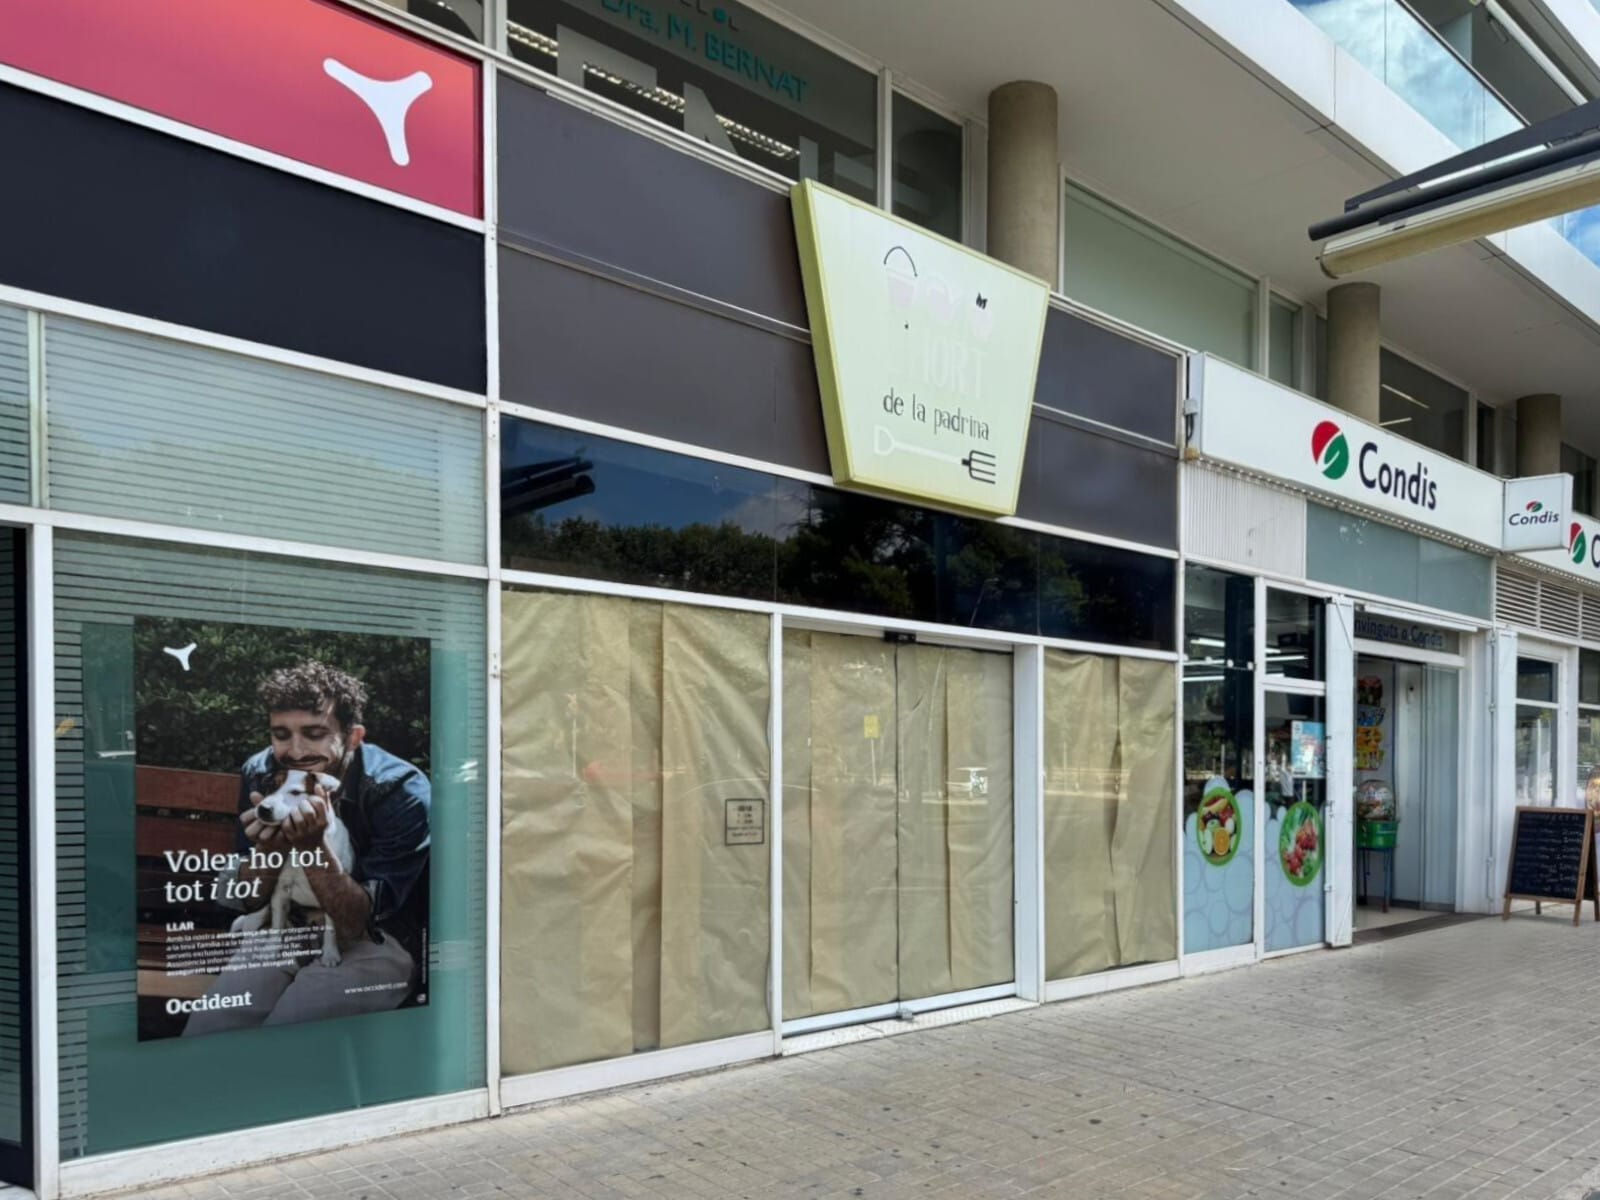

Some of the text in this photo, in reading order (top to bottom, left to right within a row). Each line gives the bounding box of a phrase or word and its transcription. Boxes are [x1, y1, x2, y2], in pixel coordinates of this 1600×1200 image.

[667, 13, 697, 51] M.
[705, 31, 808, 102] BERNAT
[883, 387, 990, 441] de la padrina
[1359, 442, 1437, 511] Condis
[1508, 511, 1560, 526] Condis
[164, 847, 329, 873] Voler-ho tot,
[165, 878, 261, 902] tot i tot
[166, 921, 195, 933] LLAR
[166, 991, 252, 1015] Occident
